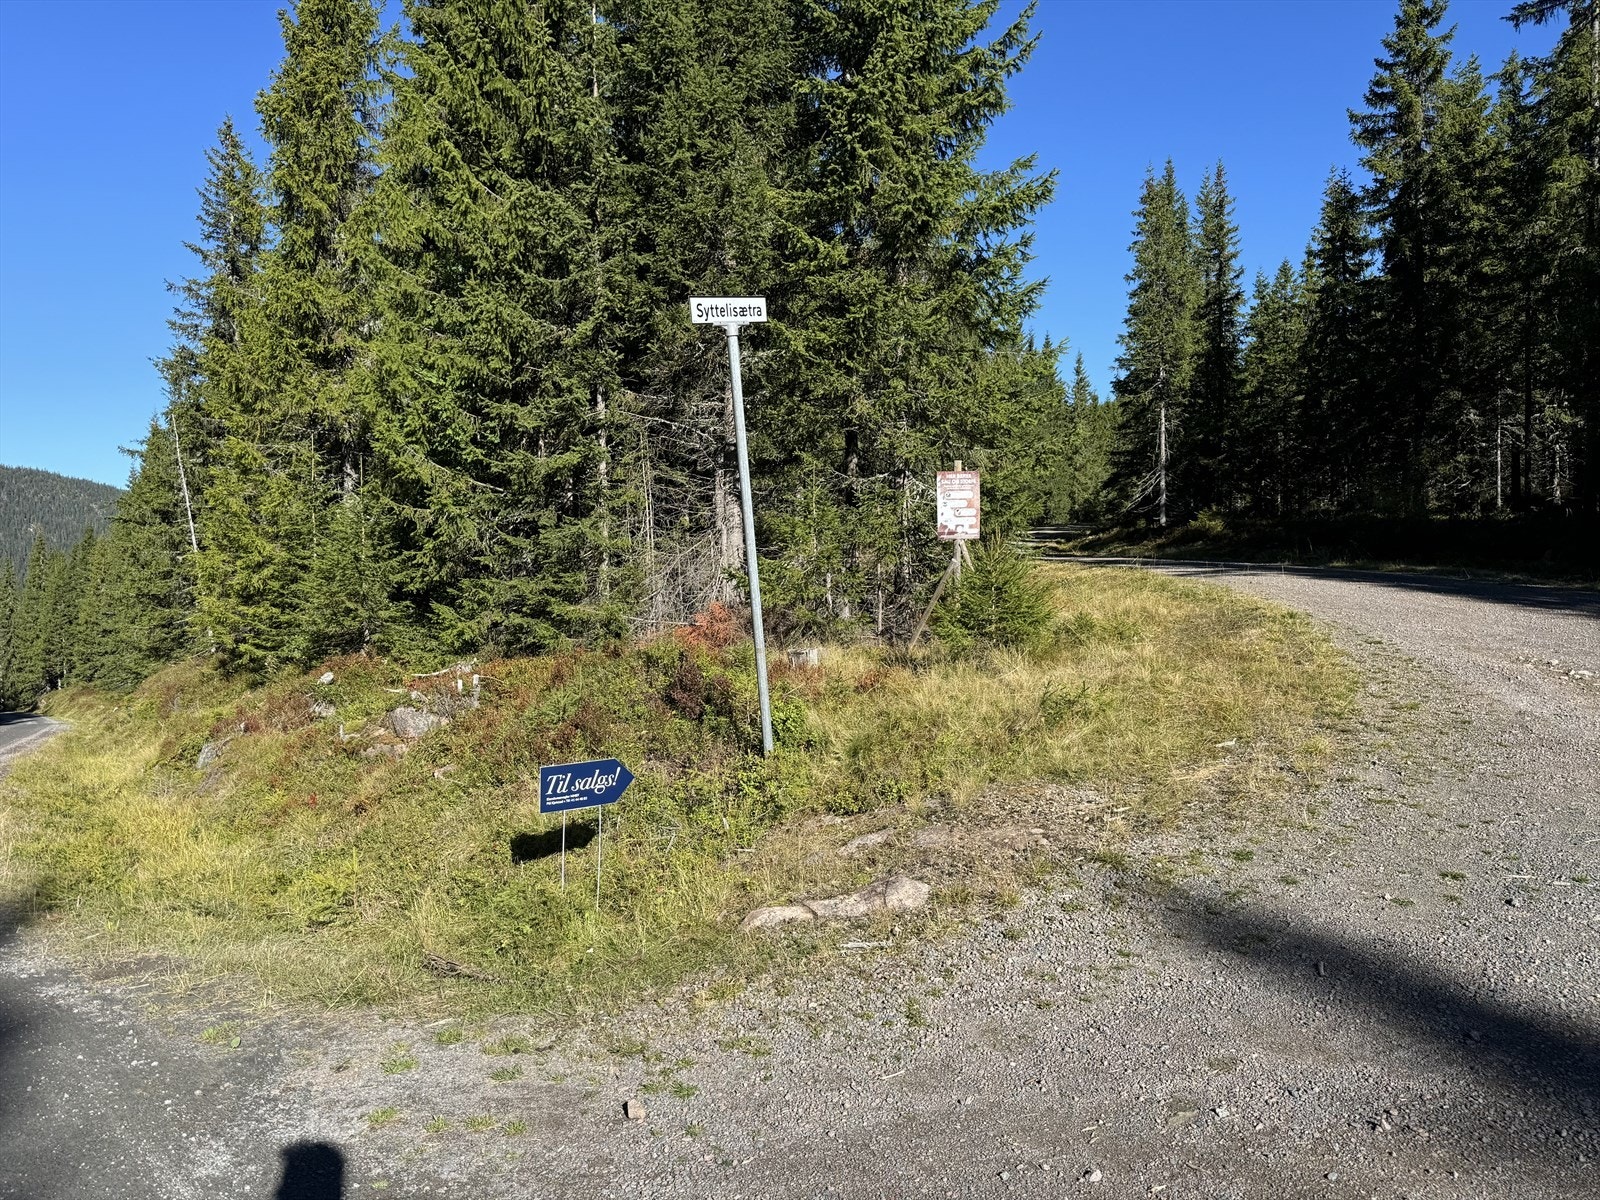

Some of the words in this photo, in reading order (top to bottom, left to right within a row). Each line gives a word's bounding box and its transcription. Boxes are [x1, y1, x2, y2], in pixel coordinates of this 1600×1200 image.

[696, 303, 762, 321] Syttelisætra
[545, 773, 572, 795] Til
[571, 766, 621, 794] salgs!
